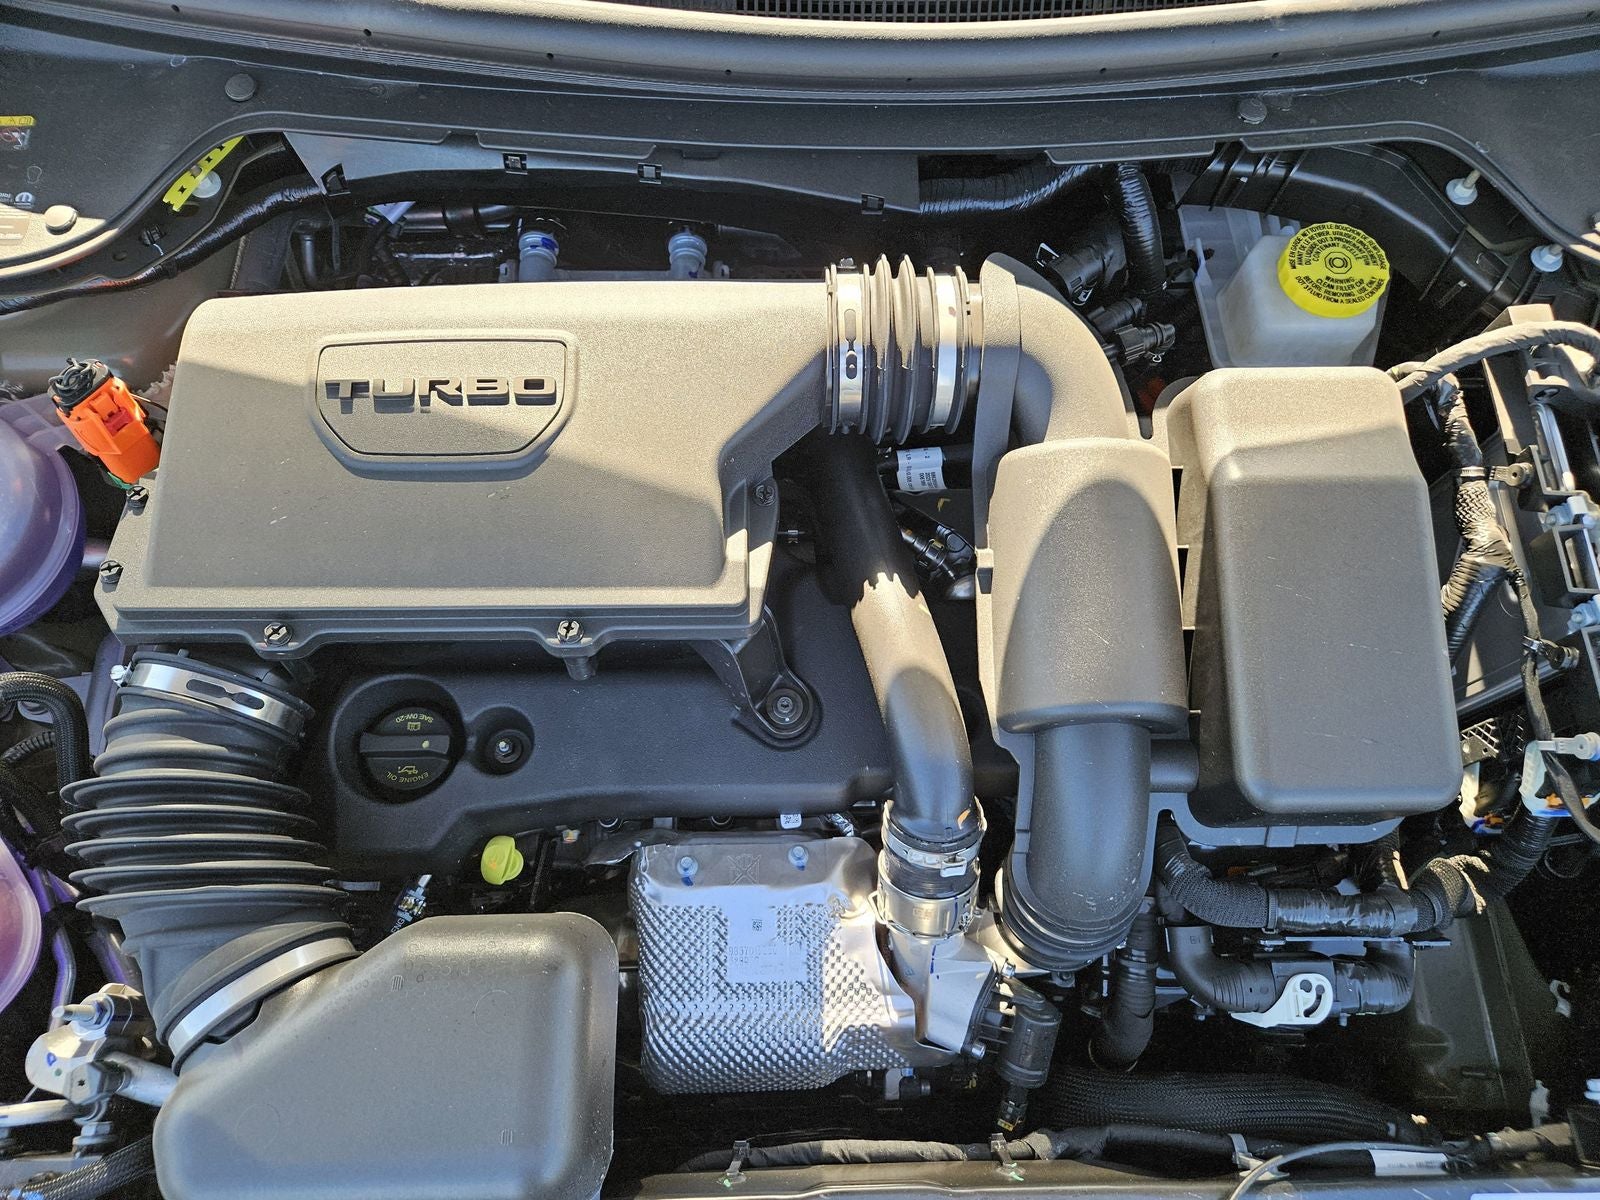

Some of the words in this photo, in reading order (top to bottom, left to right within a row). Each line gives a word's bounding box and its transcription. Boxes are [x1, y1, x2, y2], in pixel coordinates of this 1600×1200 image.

[1335, 224, 1362, 236] BOUCHON
[1312, 243, 1339, 262] CONTENANT
[1295, 275, 1306, 287] DOT
[1306, 287, 1323, 299] FLUID
[1322, 295, 1339, 303] FROM
[1345, 295, 1366, 304] SEALED
[1303, 275, 1324, 292] BEFORE
[1356, 286, 1369, 295] USE
[1365, 276, 1378, 288] ONLY
[1315, 278, 1335, 290] CLEAN
[1336, 283, 1356, 291] FILLER
[1354, 278, 1366, 288] CAP
[324, 376, 557, 413] TURBO
[419, 713, 434, 724] SAE
[386, 771, 398, 781] OIL
[399, 771, 429, 783] ENGINE
